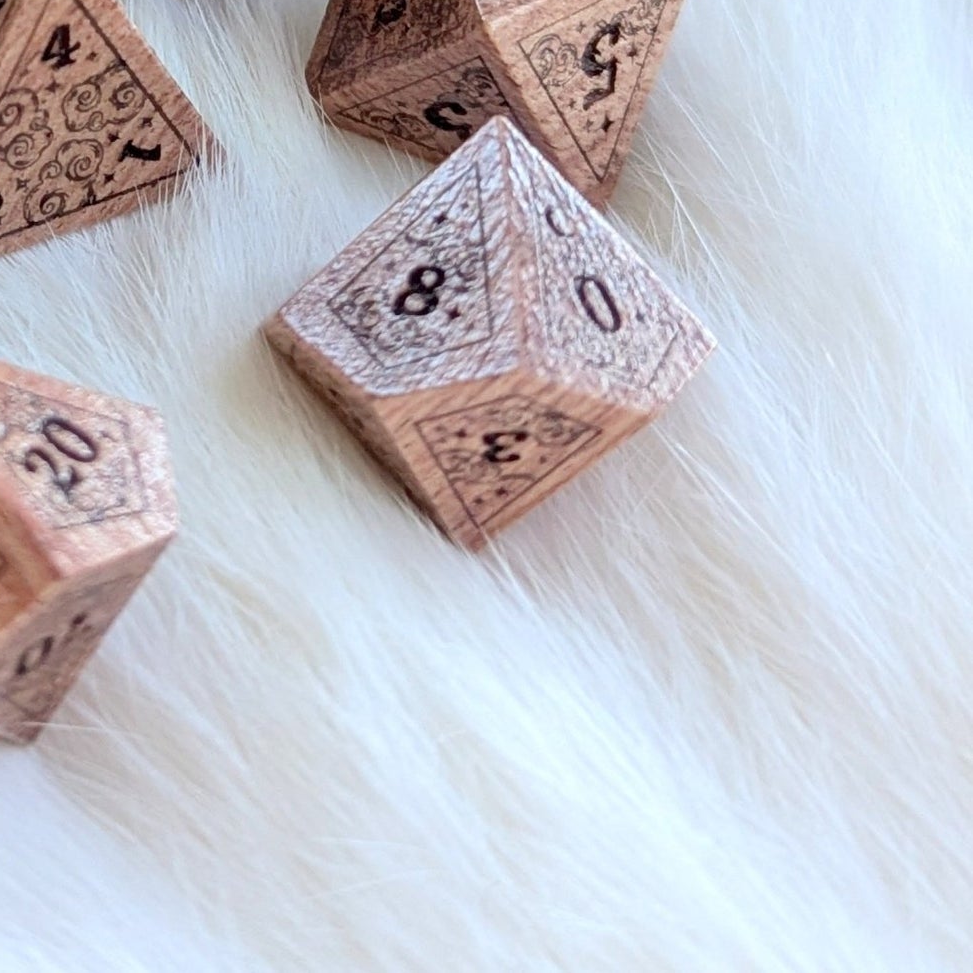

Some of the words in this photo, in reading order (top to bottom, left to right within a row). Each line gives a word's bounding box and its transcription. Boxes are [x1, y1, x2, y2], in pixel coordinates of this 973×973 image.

[41, 24, 81, 70] 4
[582, 21, 622, 111] 5
[118, 140, 162, 162] 1
[393, 265, 445, 316] 8
[575, 276, 622, 333] 0
[25, 417, 99, 504] 20
[482, 431, 529, 464] 3
